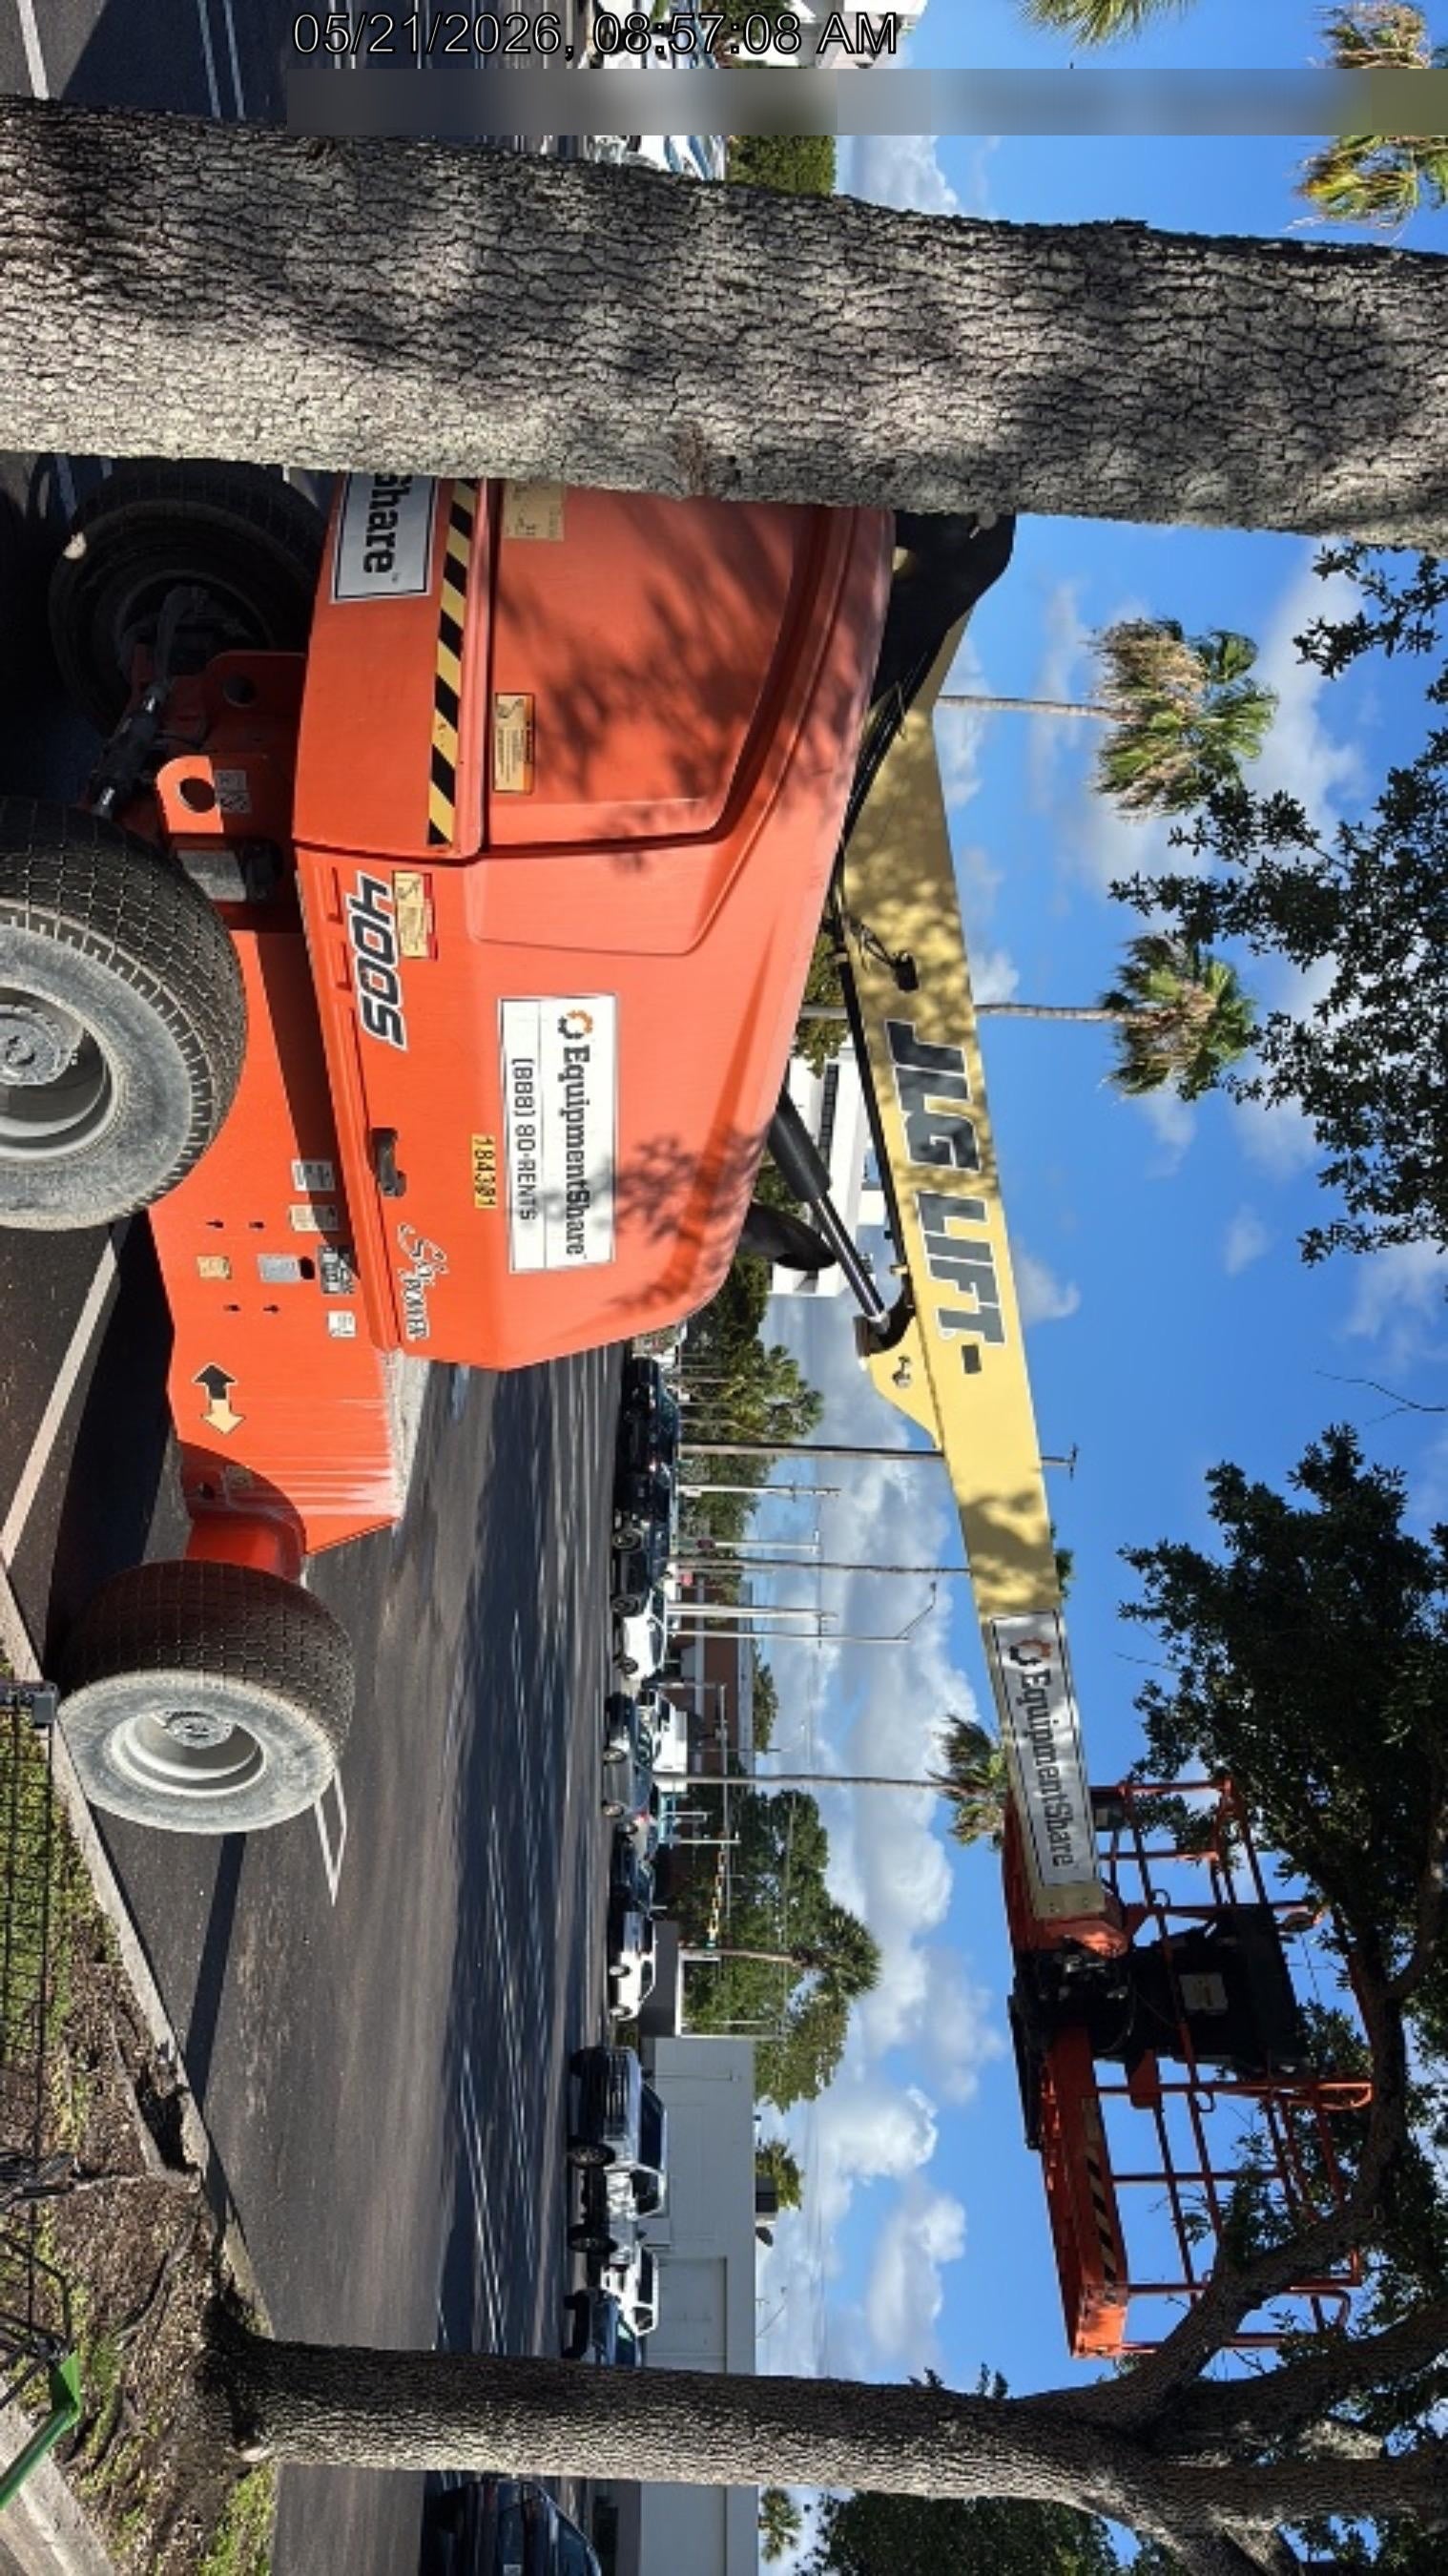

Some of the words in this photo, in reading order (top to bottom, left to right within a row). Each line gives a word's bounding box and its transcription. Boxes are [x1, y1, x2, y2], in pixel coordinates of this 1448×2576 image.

[344, 870, 407, 1051] 400S
[511, 1057, 537, 1118] (888)
[557, 1044, 590, 1256] EquipmentShare
[883, 1019, 983, 1173] JLG
[914, 1191, 1006, 1344] LIFT
[1018, 1669, 1075, 1868] EquipmentShare
